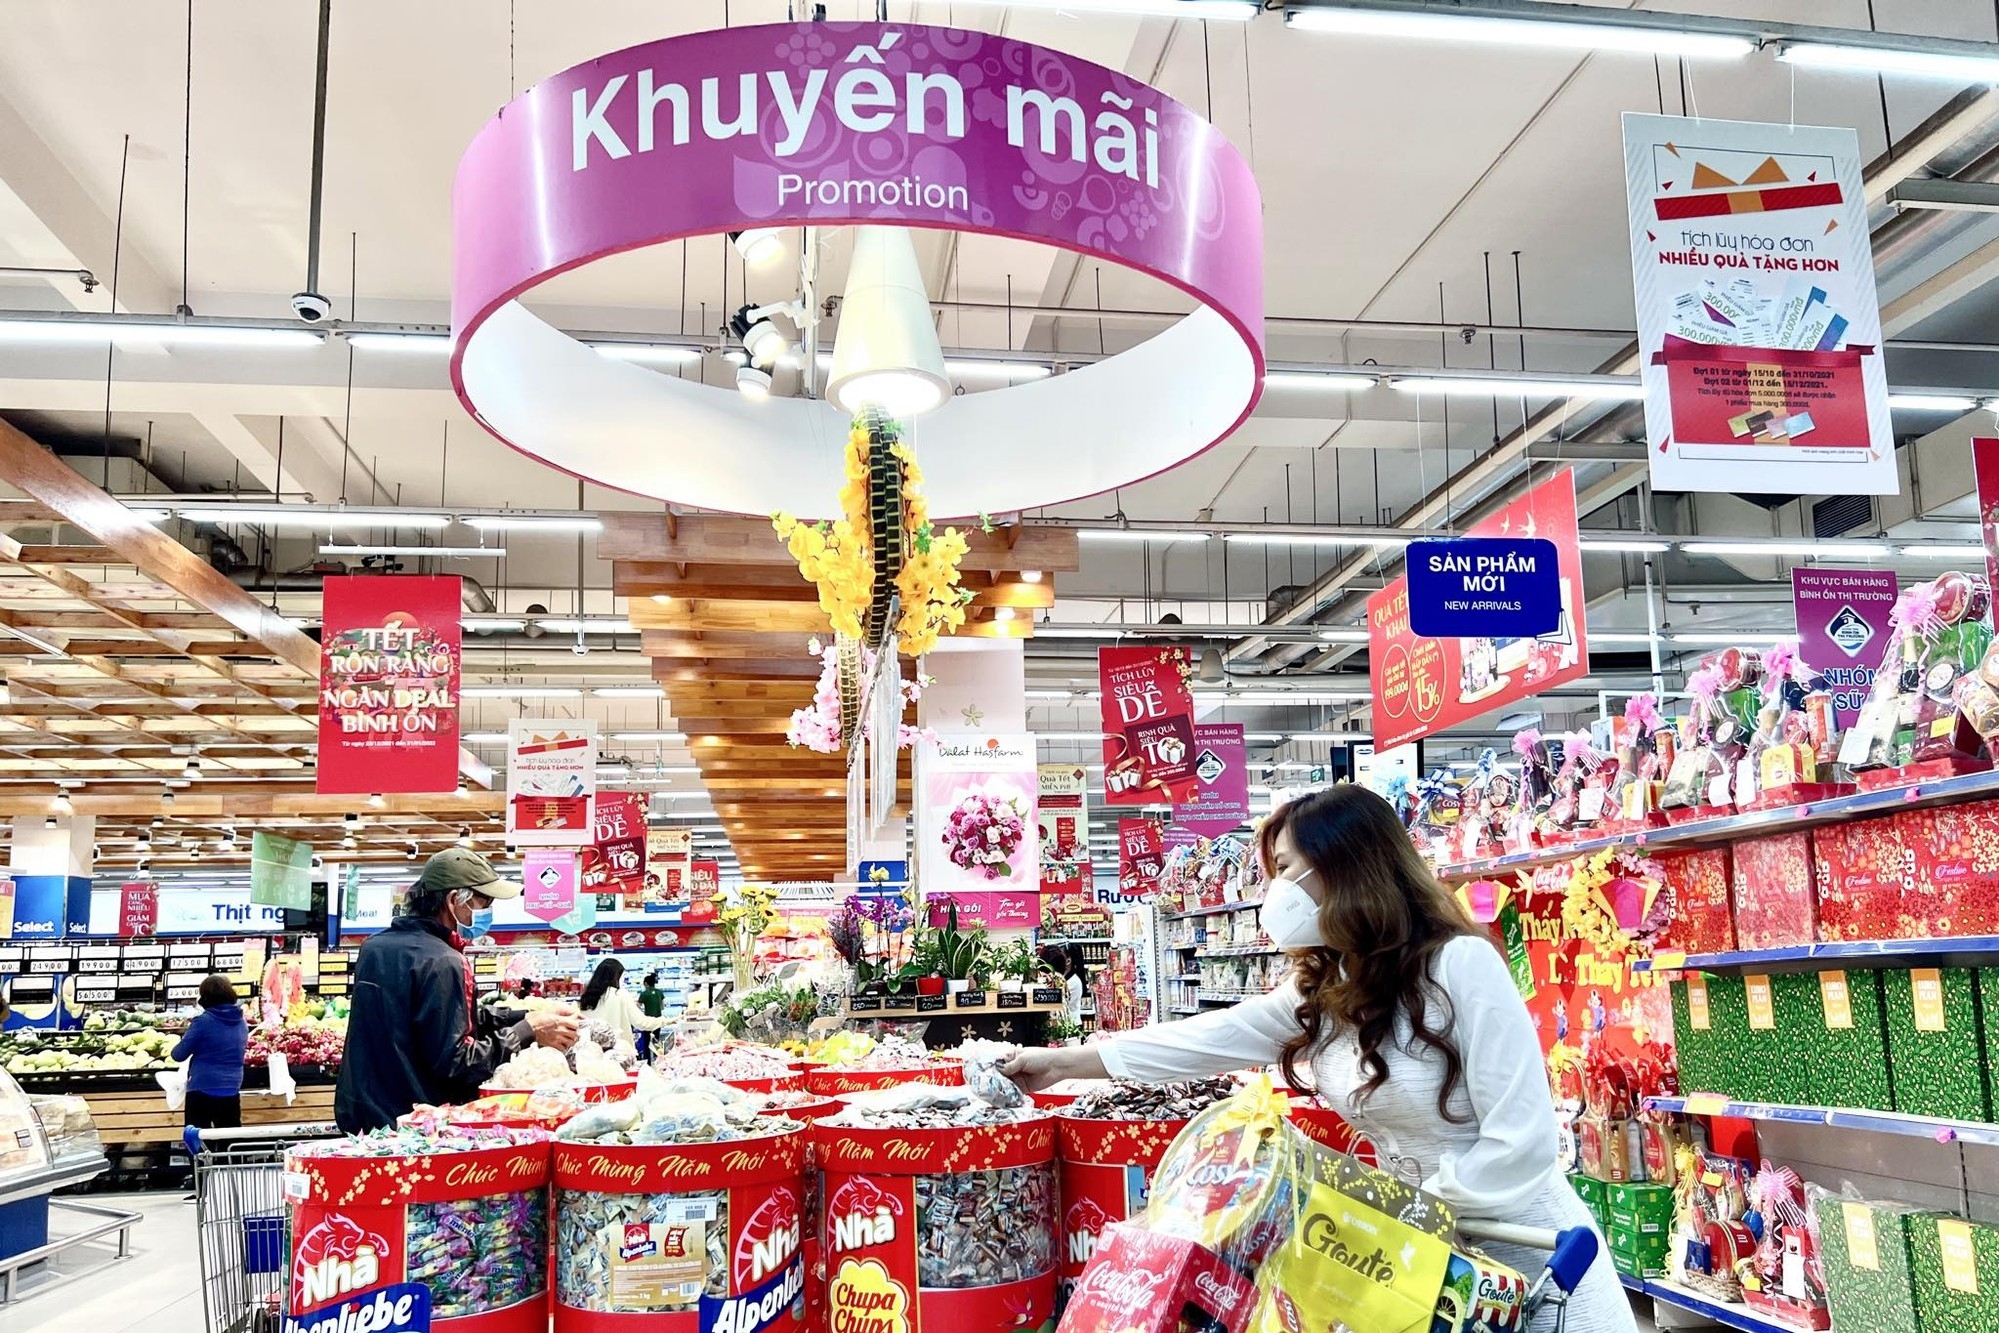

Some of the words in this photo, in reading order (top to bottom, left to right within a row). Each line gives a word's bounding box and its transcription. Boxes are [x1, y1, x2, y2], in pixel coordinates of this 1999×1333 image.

[571, 32, 966, 174] Khuyến
[1005, 89, 1162, 189] mãi
[777, 173, 969, 212] Promotion
[1681, 230, 1712, 247] tích
[1716, 232, 1738, 251] lũy
[1779, 236, 1814, 252] đơn
[1659, 246, 1709, 266] NHIỀU
[1714, 252, 1748, 269] QUÀ
[1753, 254, 1798, 273] TẶNG
[1802, 257, 1839, 272] HƠN
[1429, 552, 1471, 572] SẢN
[1477, 551, 1536, 572] PHẨM
[1464, 571, 1505, 592] MỚI
[1801, 576, 1819, 585] KHU
[1821, 577, 1841, 587] VỰC
[1842, 576, 1861, 586] BÁN
[1863, 576, 1889, 587] HÀNG
[1444, 601, 1469, 610] NEW
[1471, 601, 1521, 610] ARRIVALS
[1800, 588, 1821, 599] BÌNH
[1823, 590, 1836, 600] ỔN
[1837, 592, 1852, 602] THỊ
[1854, 590, 1893, 601] TRƯỜNG
[361, 620, 420, 652] TẾT
[331, 654, 379, 674] RỘN
[386, 649, 450, 674] RÀNG
[1110, 671, 1135, 683] TÍCH
[1136, 667, 1156, 678] LŨY
[1114, 681, 1145, 698] SIÊU
[1415, 673, 1440, 713] 15%
[1116, 680, 1167, 723] DỄ
[341, 710, 398, 733] BÌNH
[403, 707, 437, 733] ỔN
[1138, 730, 1156, 738] RINH
[1157, 723, 1176, 734] QUÀ
[1204, 728, 1218, 736] BÁN
[1219, 728, 1238, 736] HÀNG
[1212, 738, 1240, 746] TRƯỜNG
[939, 745, 970, 758] Dalat
[974, 746, 1023, 758] Hasfarm
[1040, 774, 1056, 782] Quà
[1059, 774, 1071, 782] Tết
[610, 804, 624, 813] LŨY
[126, 913, 149, 922] GIẢM
[213, 904, 251, 924] Thịt
[964, 903, 982, 913] GÓI
[14, 921, 55, 932] Select
[69, 922, 87, 934] Select
[1296, 1117, 1329, 1140] Năm
[836, 1138, 874, 1160] Năm
[882, 1139, 935, 1160] Mới
[446, 1161, 499, 1187] Chúc
[557, 1153, 583, 1175] Chúc
[587, 1155, 647, 1185] Mừng
[658, 1155, 711, 1178] Năm
[721, 1149, 769, 1172] Mới
[836, 1205, 897, 1251] Nhà
[752, 1213, 800, 1282] Nhà
[1069, 1231, 1097, 1263] Nh
[303, 1244, 379, 1308] Nhà
[1082, 1260, 1167, 1310] Coca-Cola
[836, 1283, 897, 1313] Chupa
[1195, 1271, 1242, 1311] Coca-Cola
